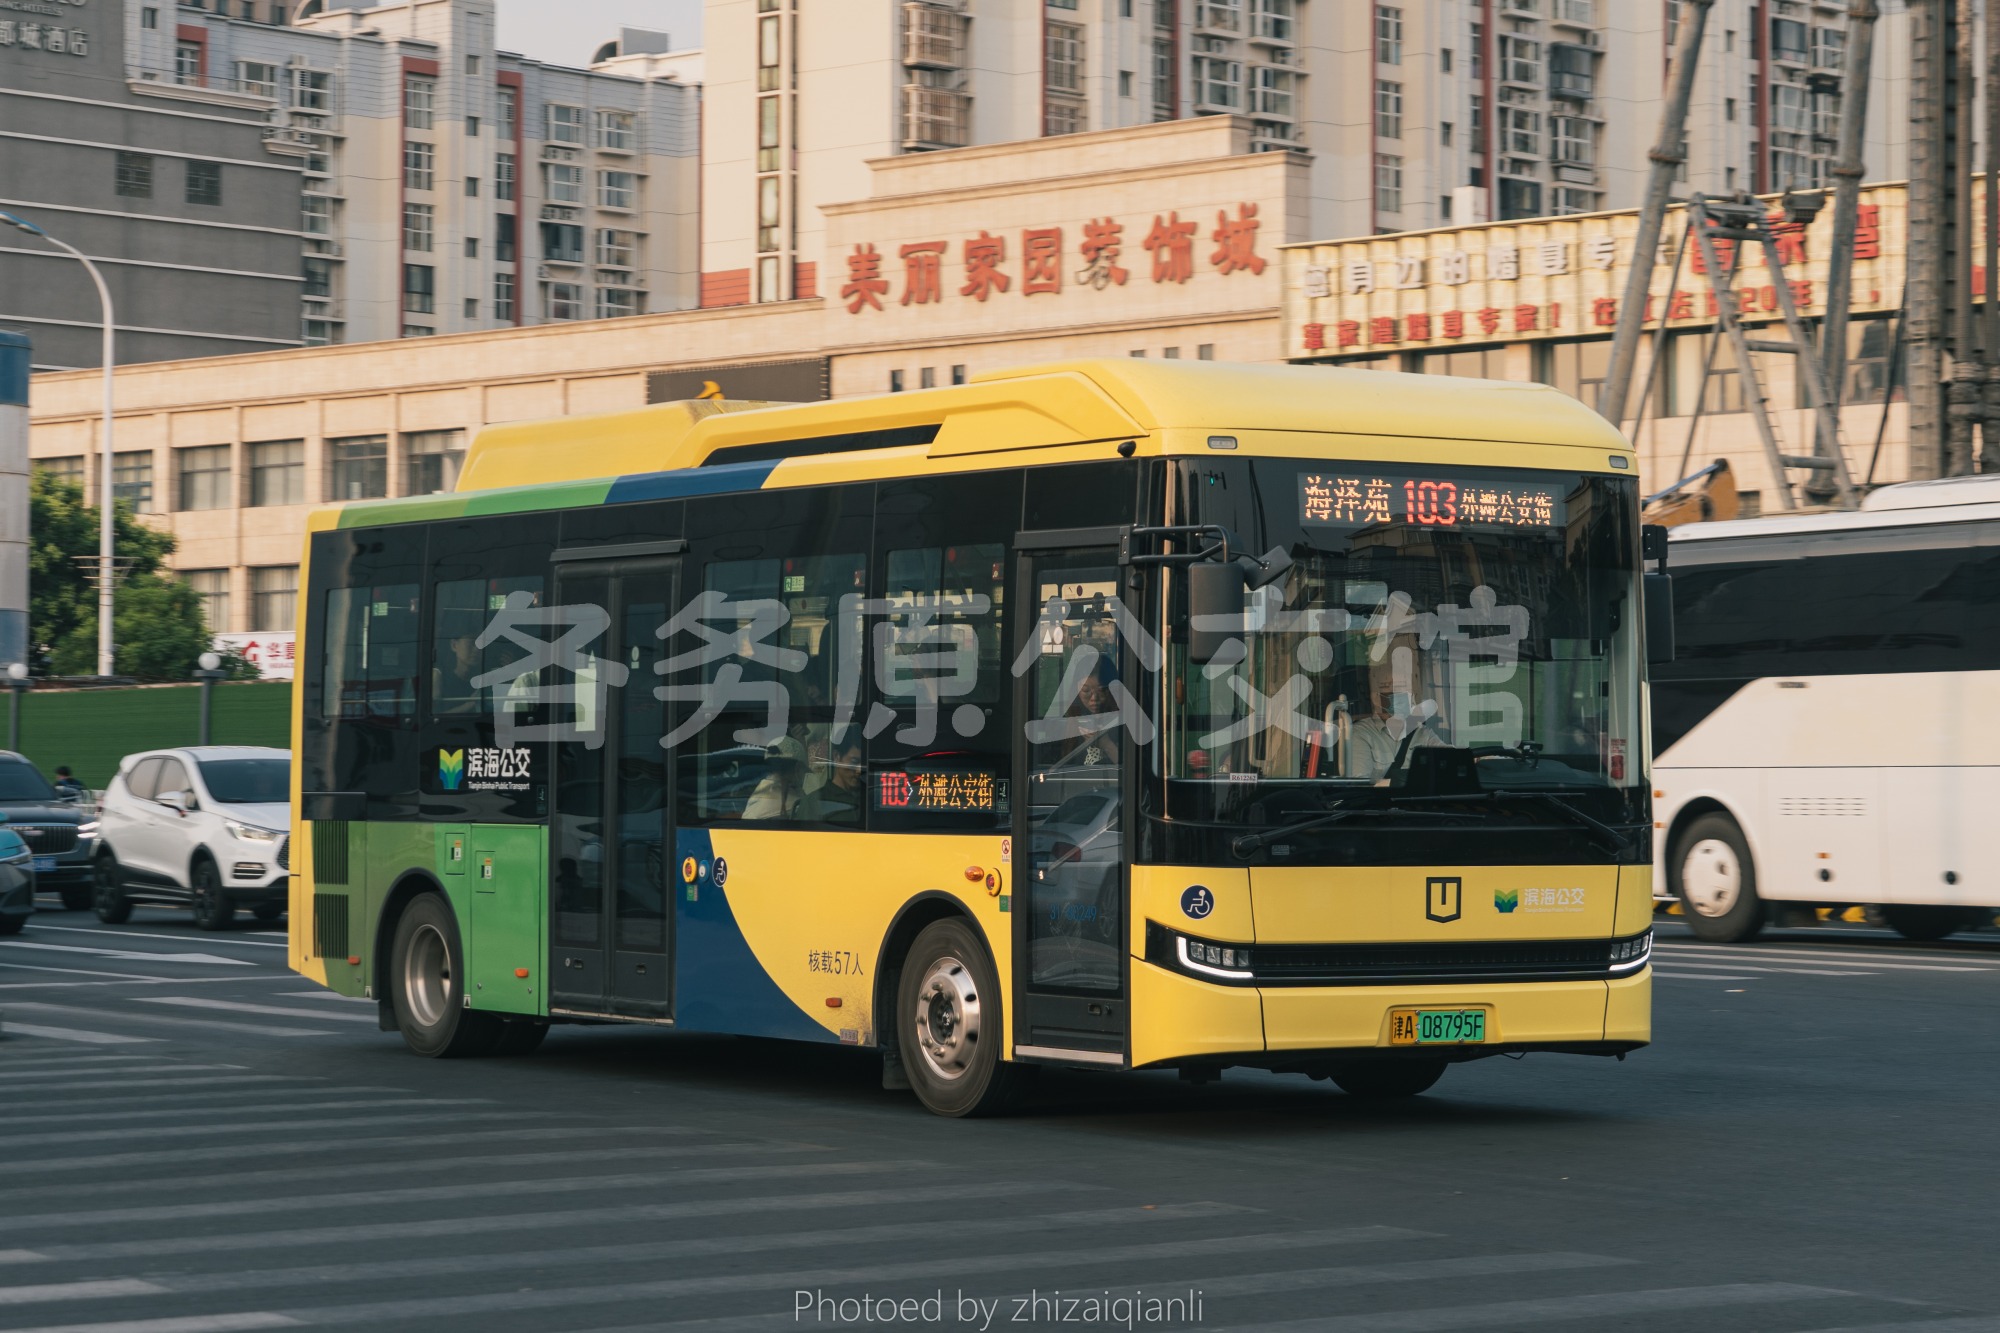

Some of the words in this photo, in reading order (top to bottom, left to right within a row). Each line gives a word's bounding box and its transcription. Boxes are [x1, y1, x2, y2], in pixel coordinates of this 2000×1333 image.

[841, 202, 1267, 314] 美丽家园装饰城
[1403, 480, 1457, 526] 103
[467, 748, 531, 778] 滨海公交
[880, 771, 909, 806] 103
[1524, 887, 1585, 906] 滨海公交
[808, 949, 864, 976] 核载57人
